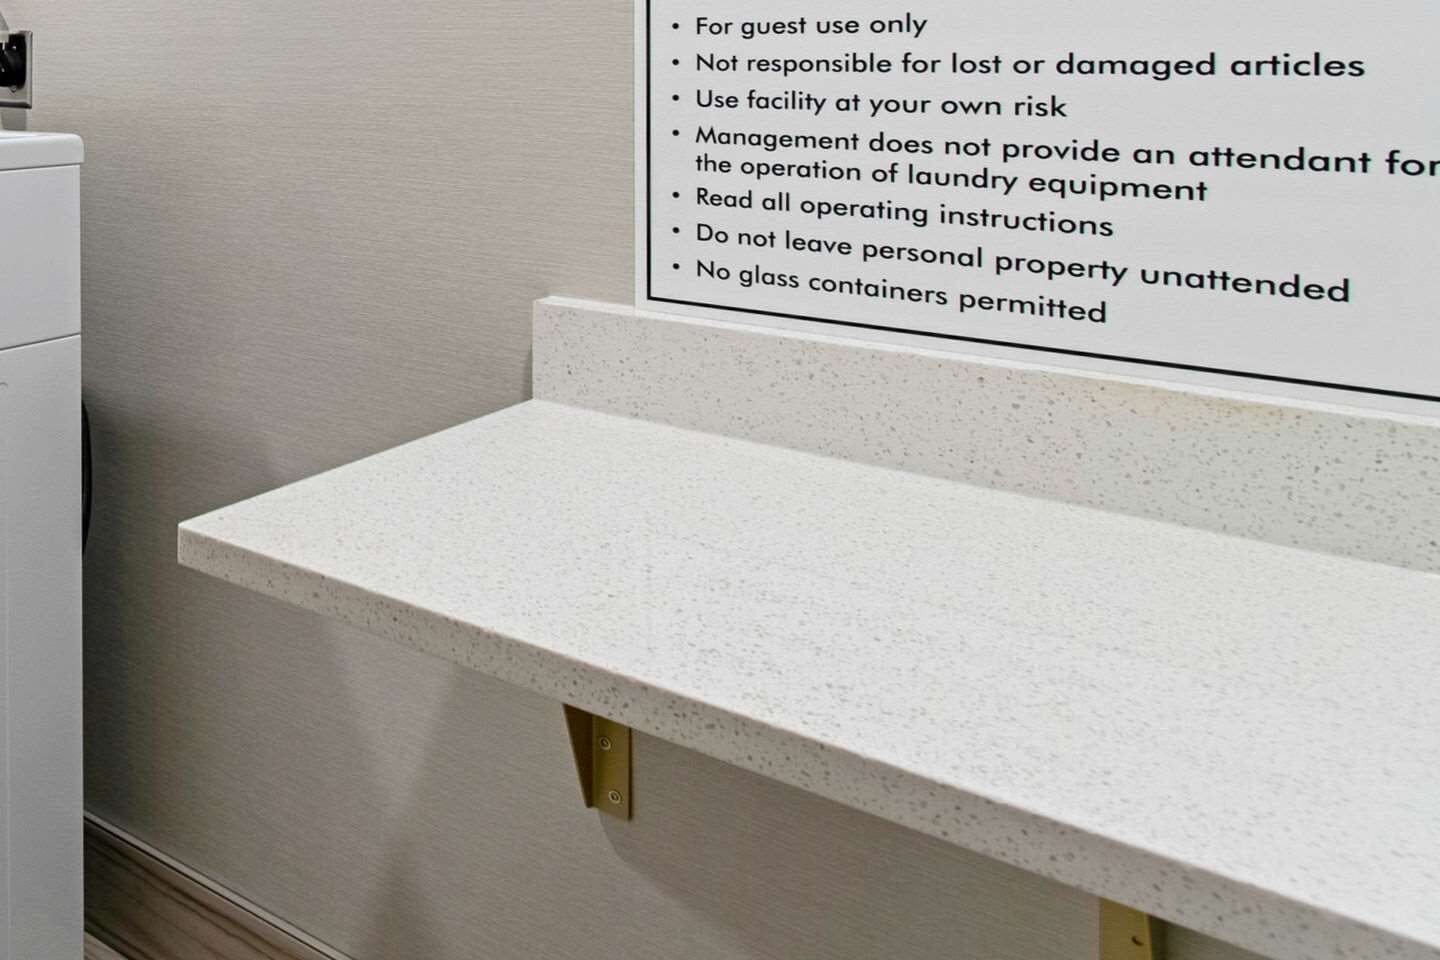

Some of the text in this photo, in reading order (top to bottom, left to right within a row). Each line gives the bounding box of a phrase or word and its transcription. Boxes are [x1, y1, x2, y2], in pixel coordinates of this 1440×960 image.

[696, 12, 928, 40] For guest use only
[696, 51, 1365, 81] Not responsible for lost or damaged articles
[696, 89, 1067, 118] Use facility at your own risk
[695, 126, 1440, 177] Management does not provide an attendant for
[695, 152, 1208, 202] the operation of laundry equipment
[696, 187, 1114, 237] Read all operating instructions
[697, 223, 1350, 303] Do not leave personal property unattended
[697, 259, 1106, 324] No glass containers permitted
